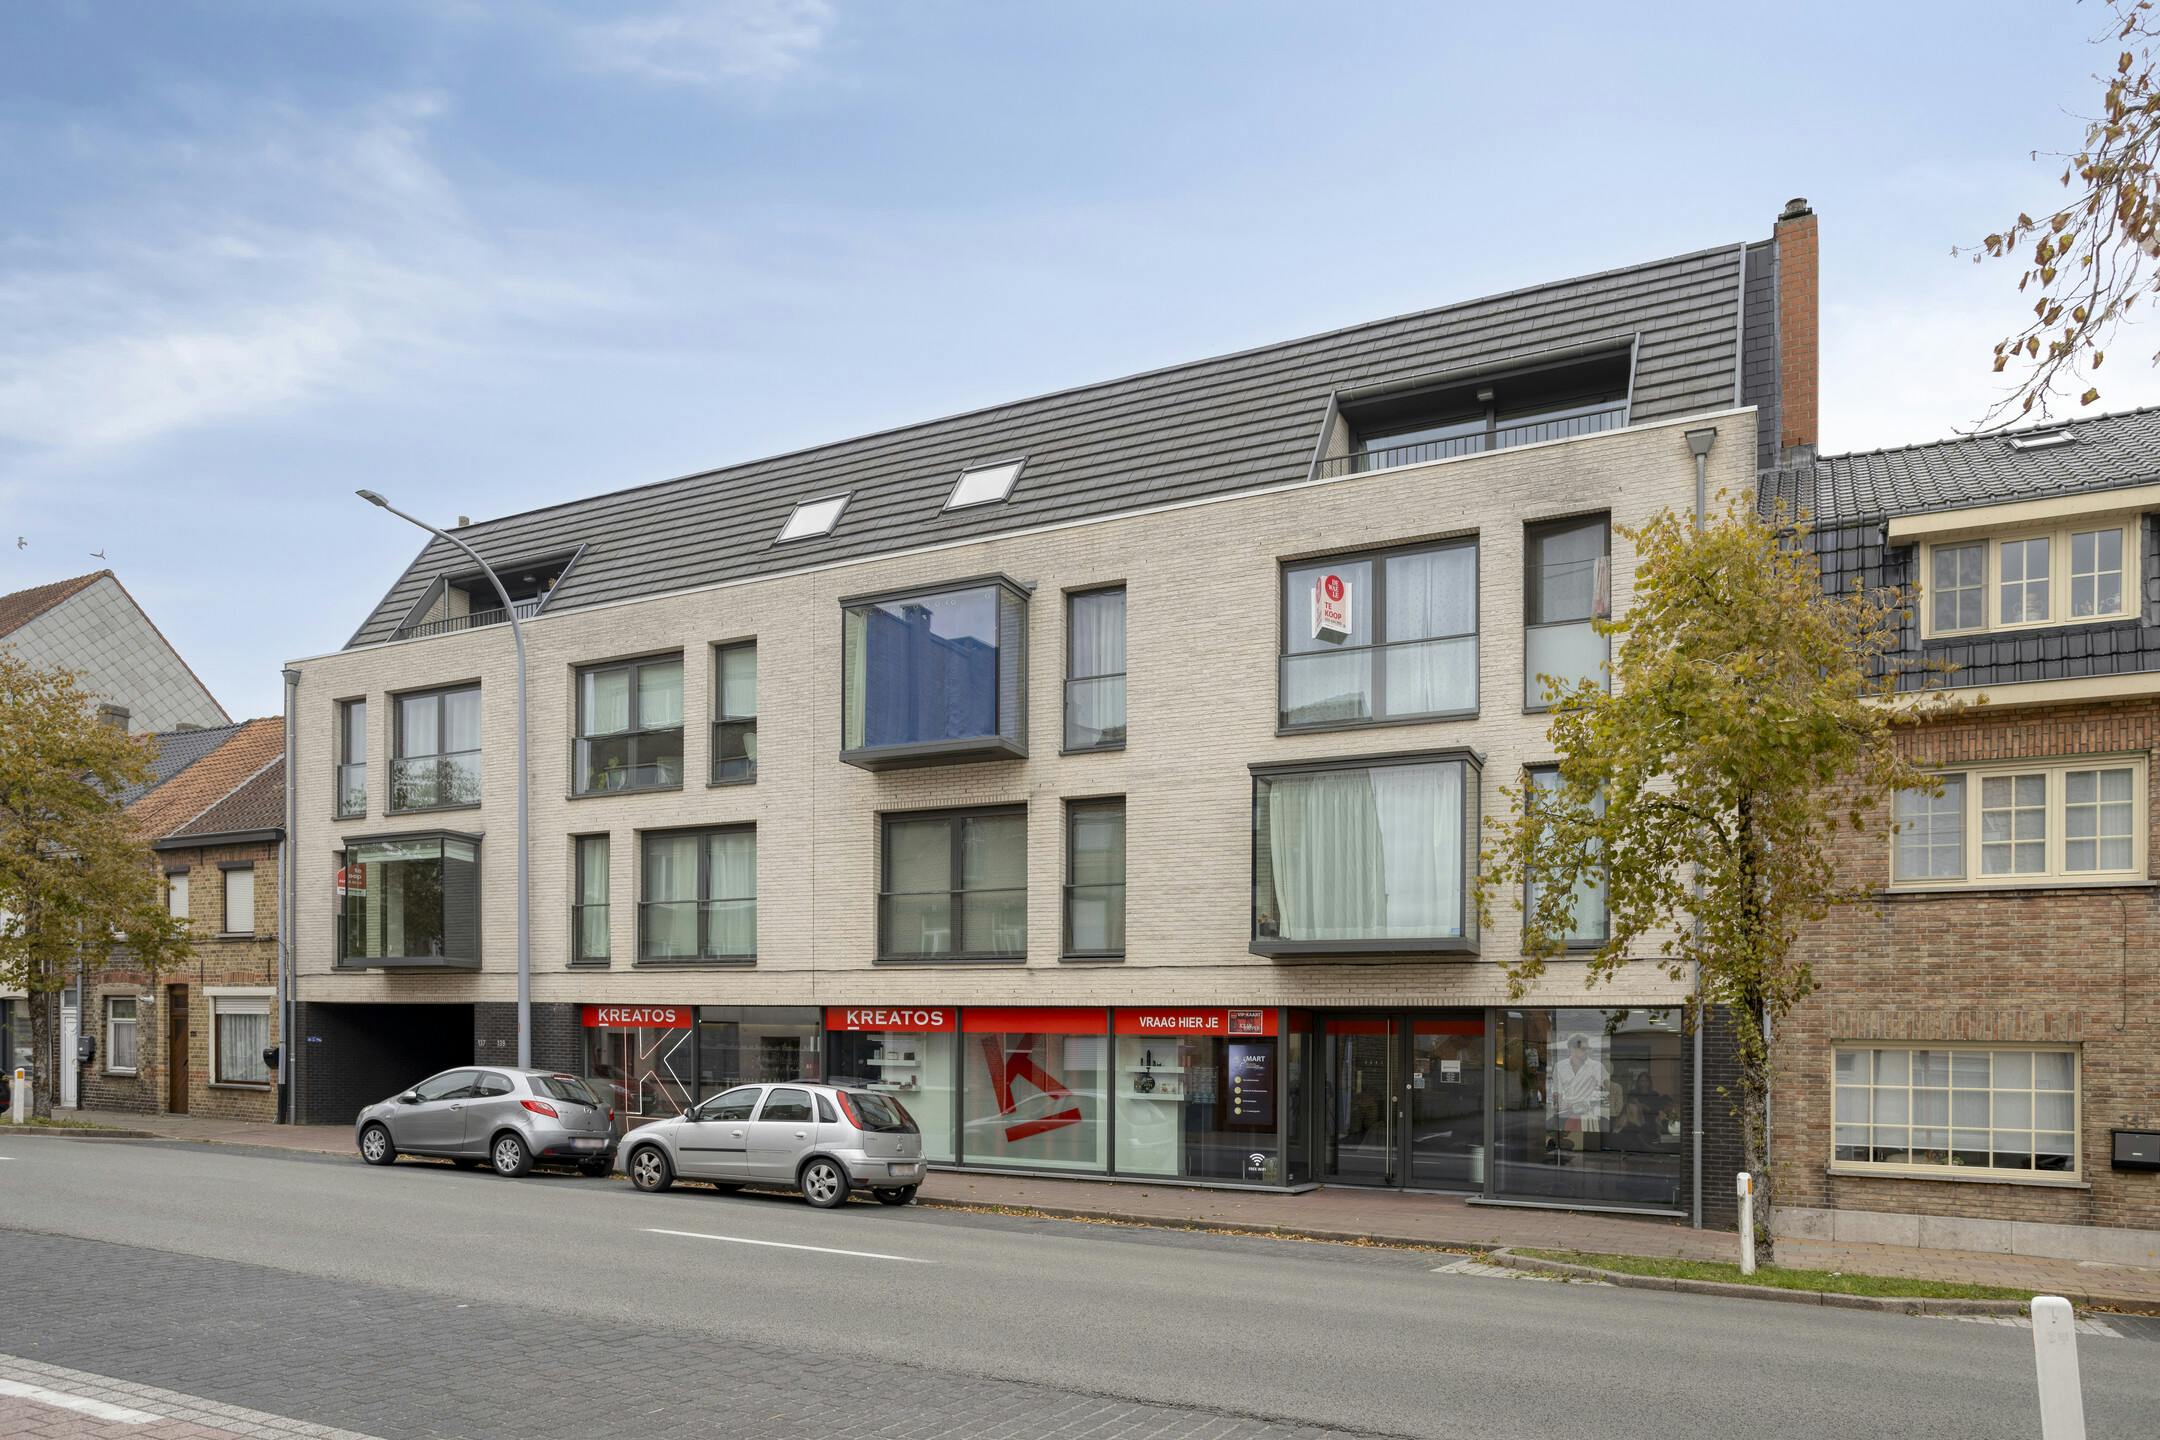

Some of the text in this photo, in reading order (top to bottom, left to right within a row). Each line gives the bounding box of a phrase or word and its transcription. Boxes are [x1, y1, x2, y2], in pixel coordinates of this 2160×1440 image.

[1325, 611, 1341, 619] KOOP
[598, 1008, 676, 1023] KREATOS
[847, 1010, 943, 1025] KREATOS
[1139, 1016, 1219, 1028] VRAAG HIER JE
